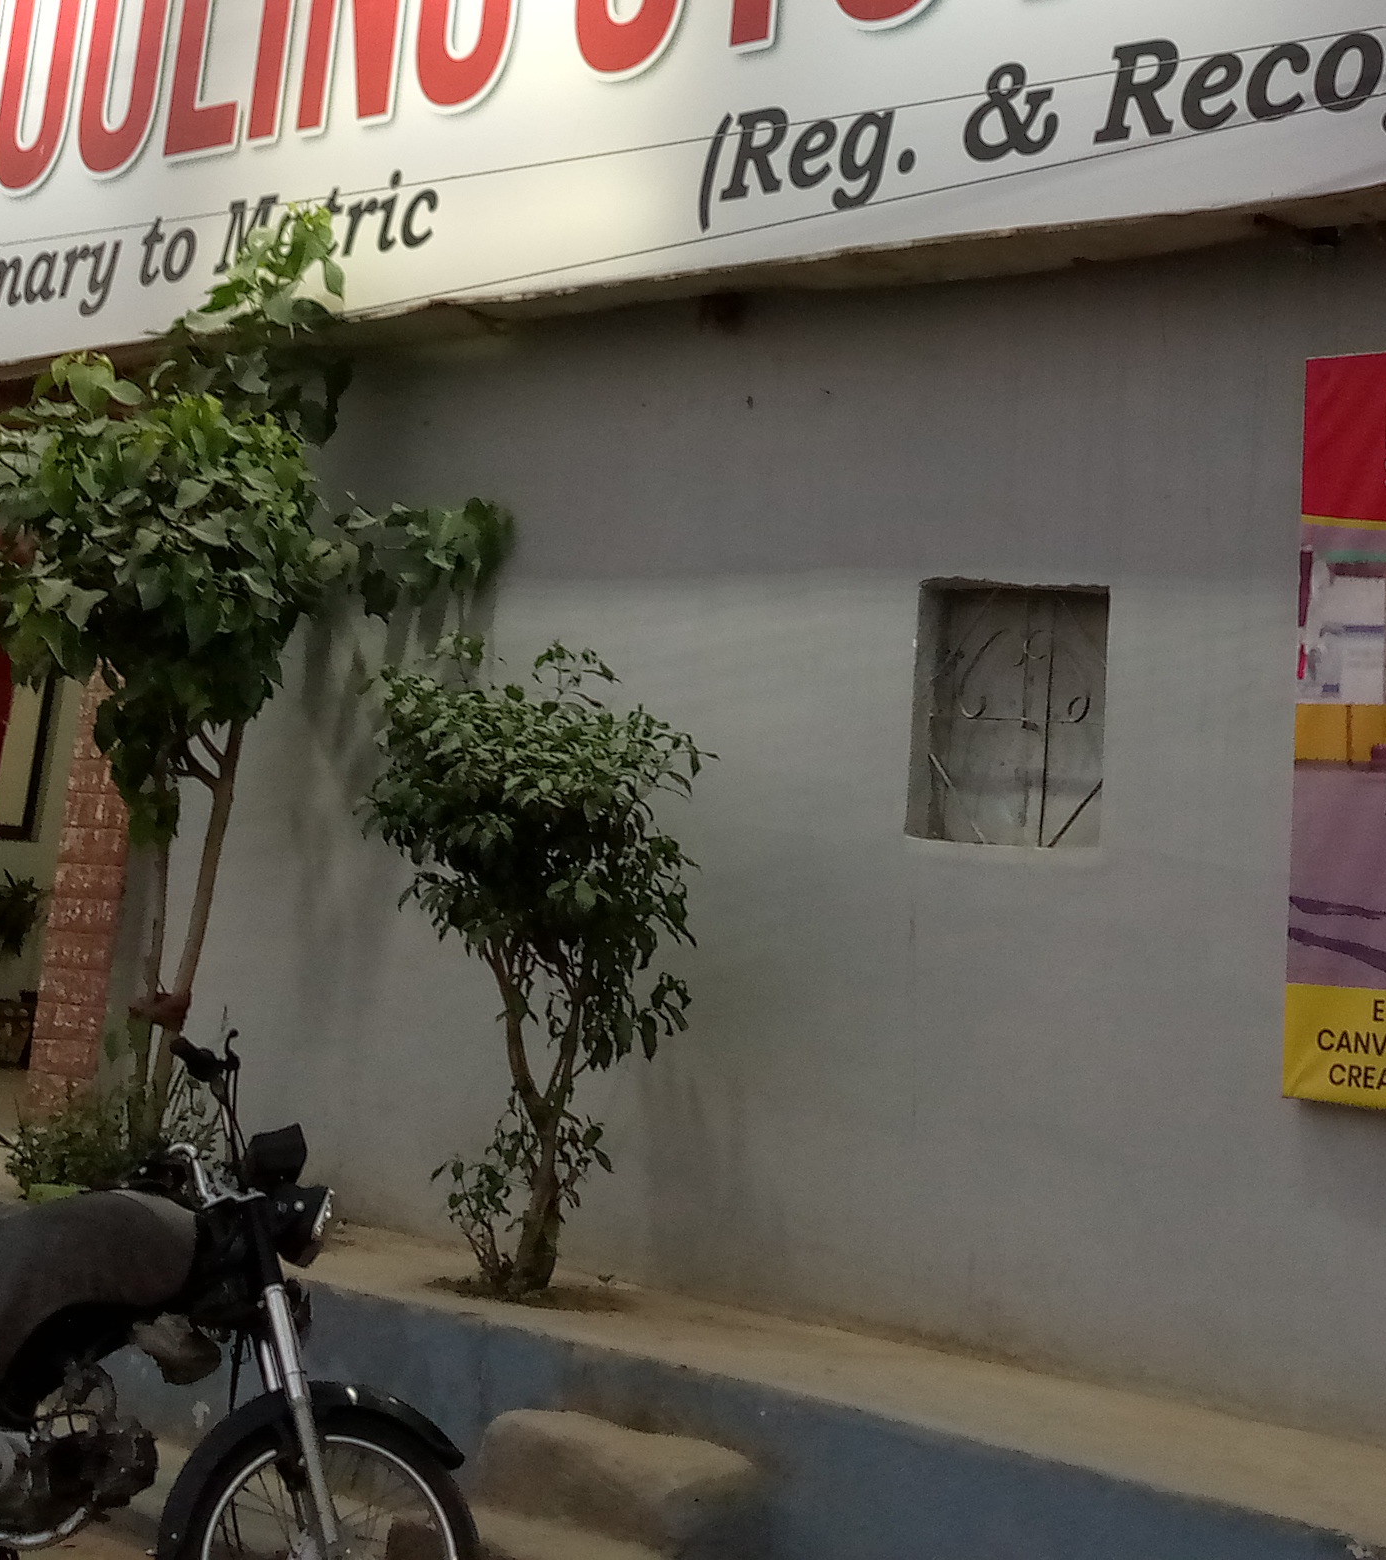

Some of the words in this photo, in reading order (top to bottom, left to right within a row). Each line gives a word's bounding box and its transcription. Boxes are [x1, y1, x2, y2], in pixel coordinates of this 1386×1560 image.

[698, 104, 915, 233] (Reg.
[963, 62, 1060, 165] &
[139, 216, 196, 286] to
